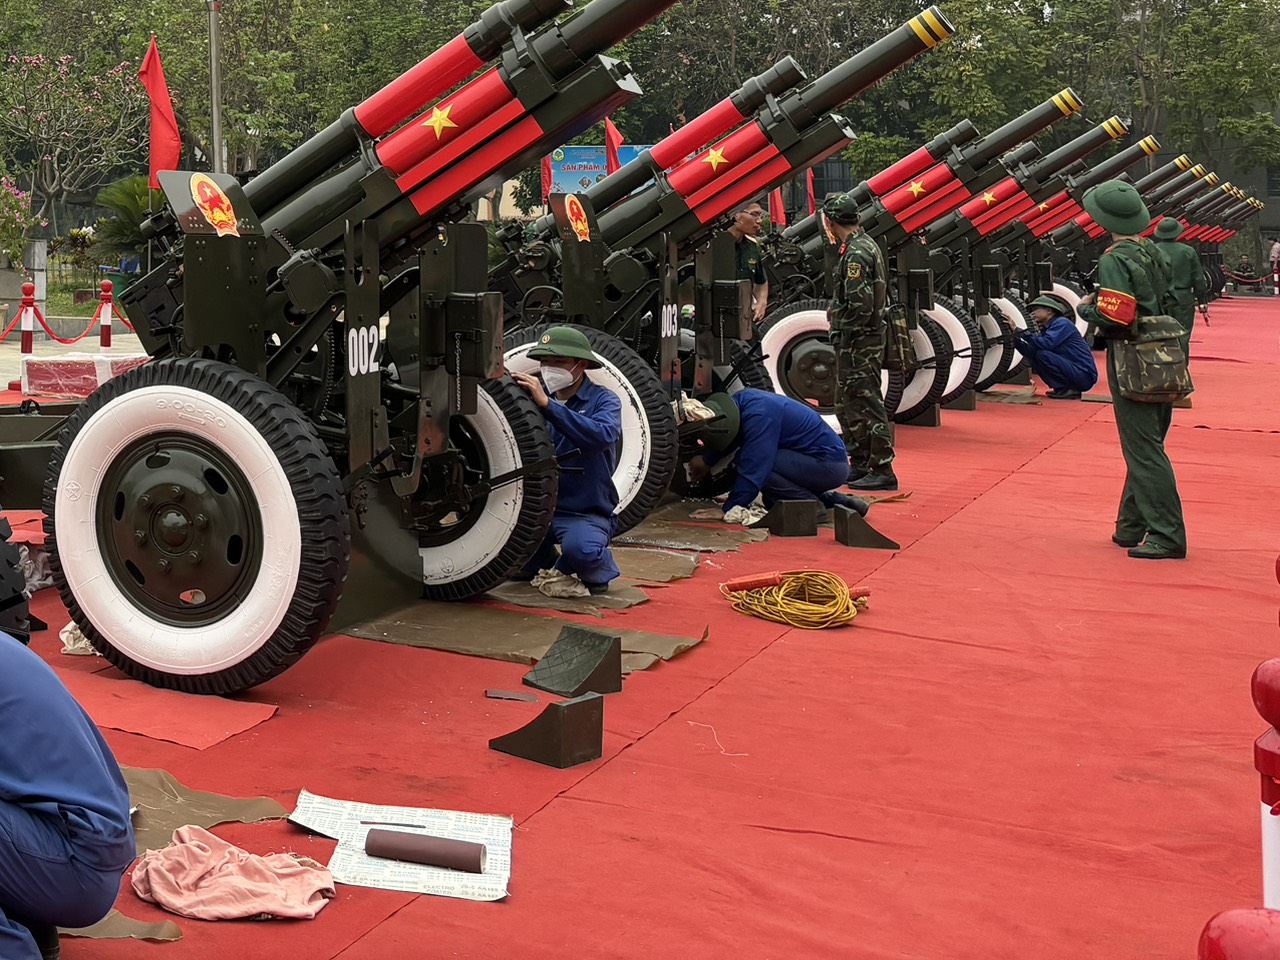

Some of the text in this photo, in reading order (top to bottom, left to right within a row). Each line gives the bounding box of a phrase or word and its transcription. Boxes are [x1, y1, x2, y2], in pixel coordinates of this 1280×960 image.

[661, 303, 678, 339] 003
[348, 325, 379, 377] 002
[155, 398, 228, 428] 9.00-20
